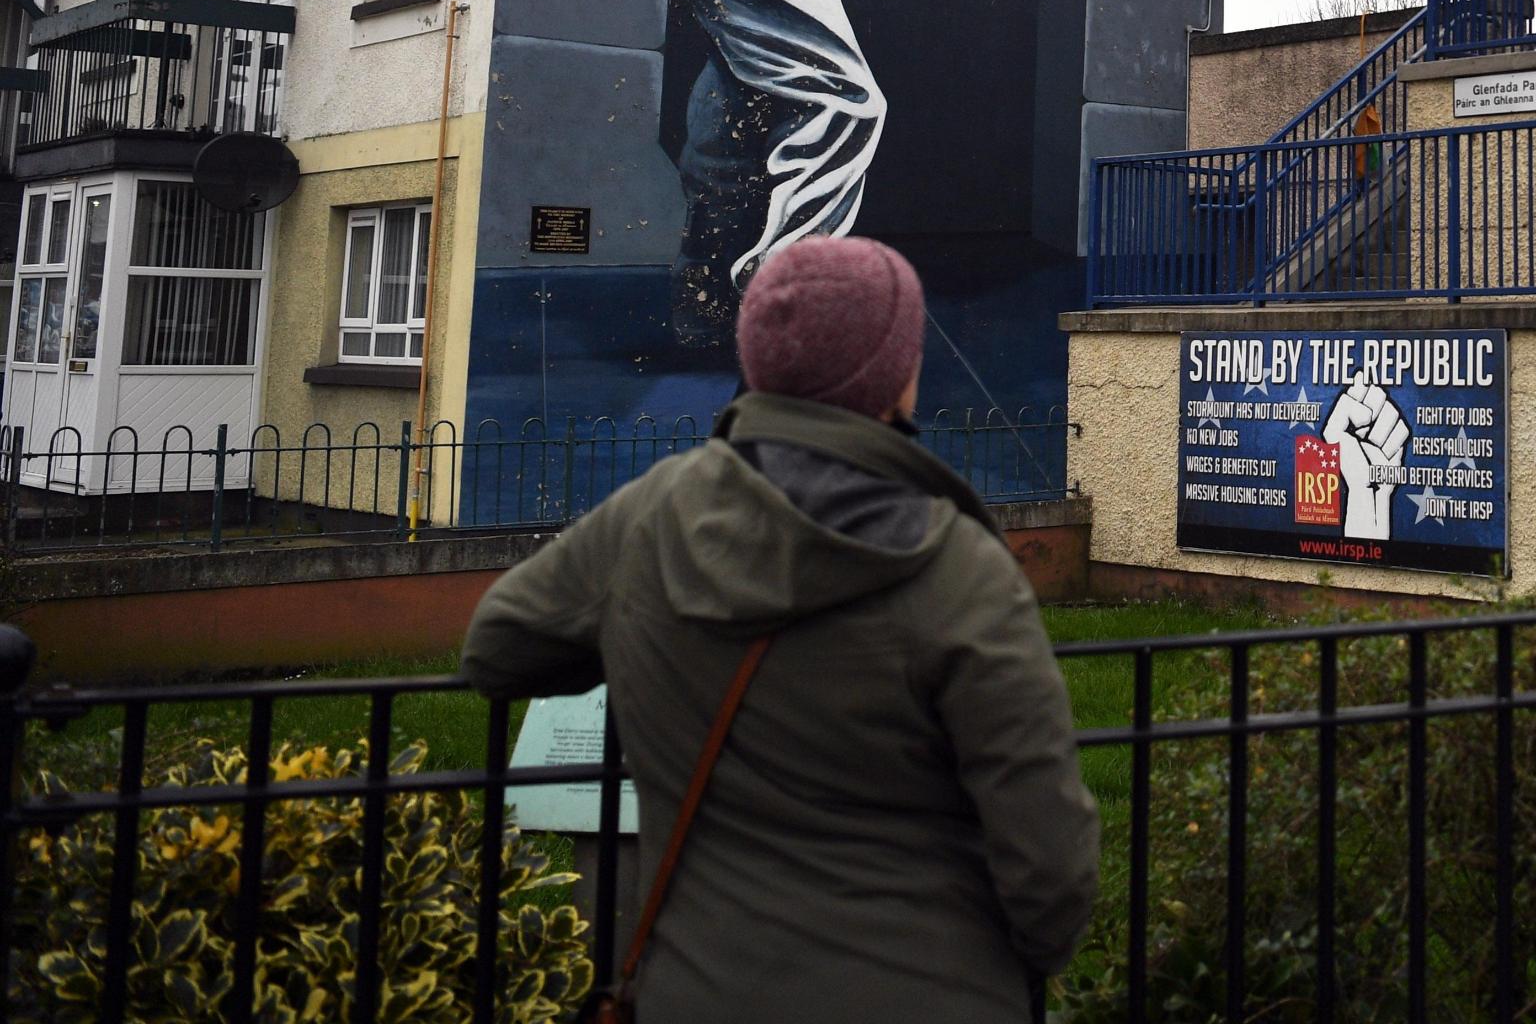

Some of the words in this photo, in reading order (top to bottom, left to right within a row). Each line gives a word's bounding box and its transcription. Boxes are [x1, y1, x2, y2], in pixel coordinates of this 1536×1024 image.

[1473, 82, 1518, 95] Glenfada
[1494, 94, 1534, 105] Ghleanna
[1189, 339, 1264, 383] STAND
[1271, 339, 1303, 384] BY
[1309, 339, 1355, 384] THE
[1363, 339, 1493, 386] REPUBLIC
[1187, 401, 1234, 419] STORMOUNT
[1236, 402, 1253, 419] HAS
[1255, 402, 1271, 420] NOT
[1273, 403, 1320, 421] DELIVERED!
[1416, 406, 1444, 425] FIGHT
[1446, 407, 1466, 425] FOR
[1467, 408, 1493, 426] JOBS
[1186, 428, 1198, 444] NO
[1199, 429, 1217, 445] NEW
[1218, 430, 1239, 446] JOBS
[1412, 437, 1446, 455] RESIST
[1447, 438, 1465, 456] ALL
[1467, 439, 1493, 457] CUTS
[1186, 455, 1213, 473] WAGES
[1215, 458, 1221, 473] &
[1222, 458, 1259, 476] BENEFITS
[1260, 460, 1277, 477] CUT
[1369, 465, 1407, 484] DEMAND
[1410, 467, 1443, 486] BETTER
[1446, 469, 1493, 489] SERVICES
[1185, 483, 1220, 502] MASSIVE
[1220, 486, 1257, 505] HOUSING
[1258, 488, 1287, 507] CRISIS
[1298, 471, 1339, 505] IRSP
[1424, 498, 1447, 517] JOIN
[1449, 500, 1467, 518] THE
[1469, 501, 1493, 520] IRSP
[1299, 539, 1383, 560] www.irsp.ie
